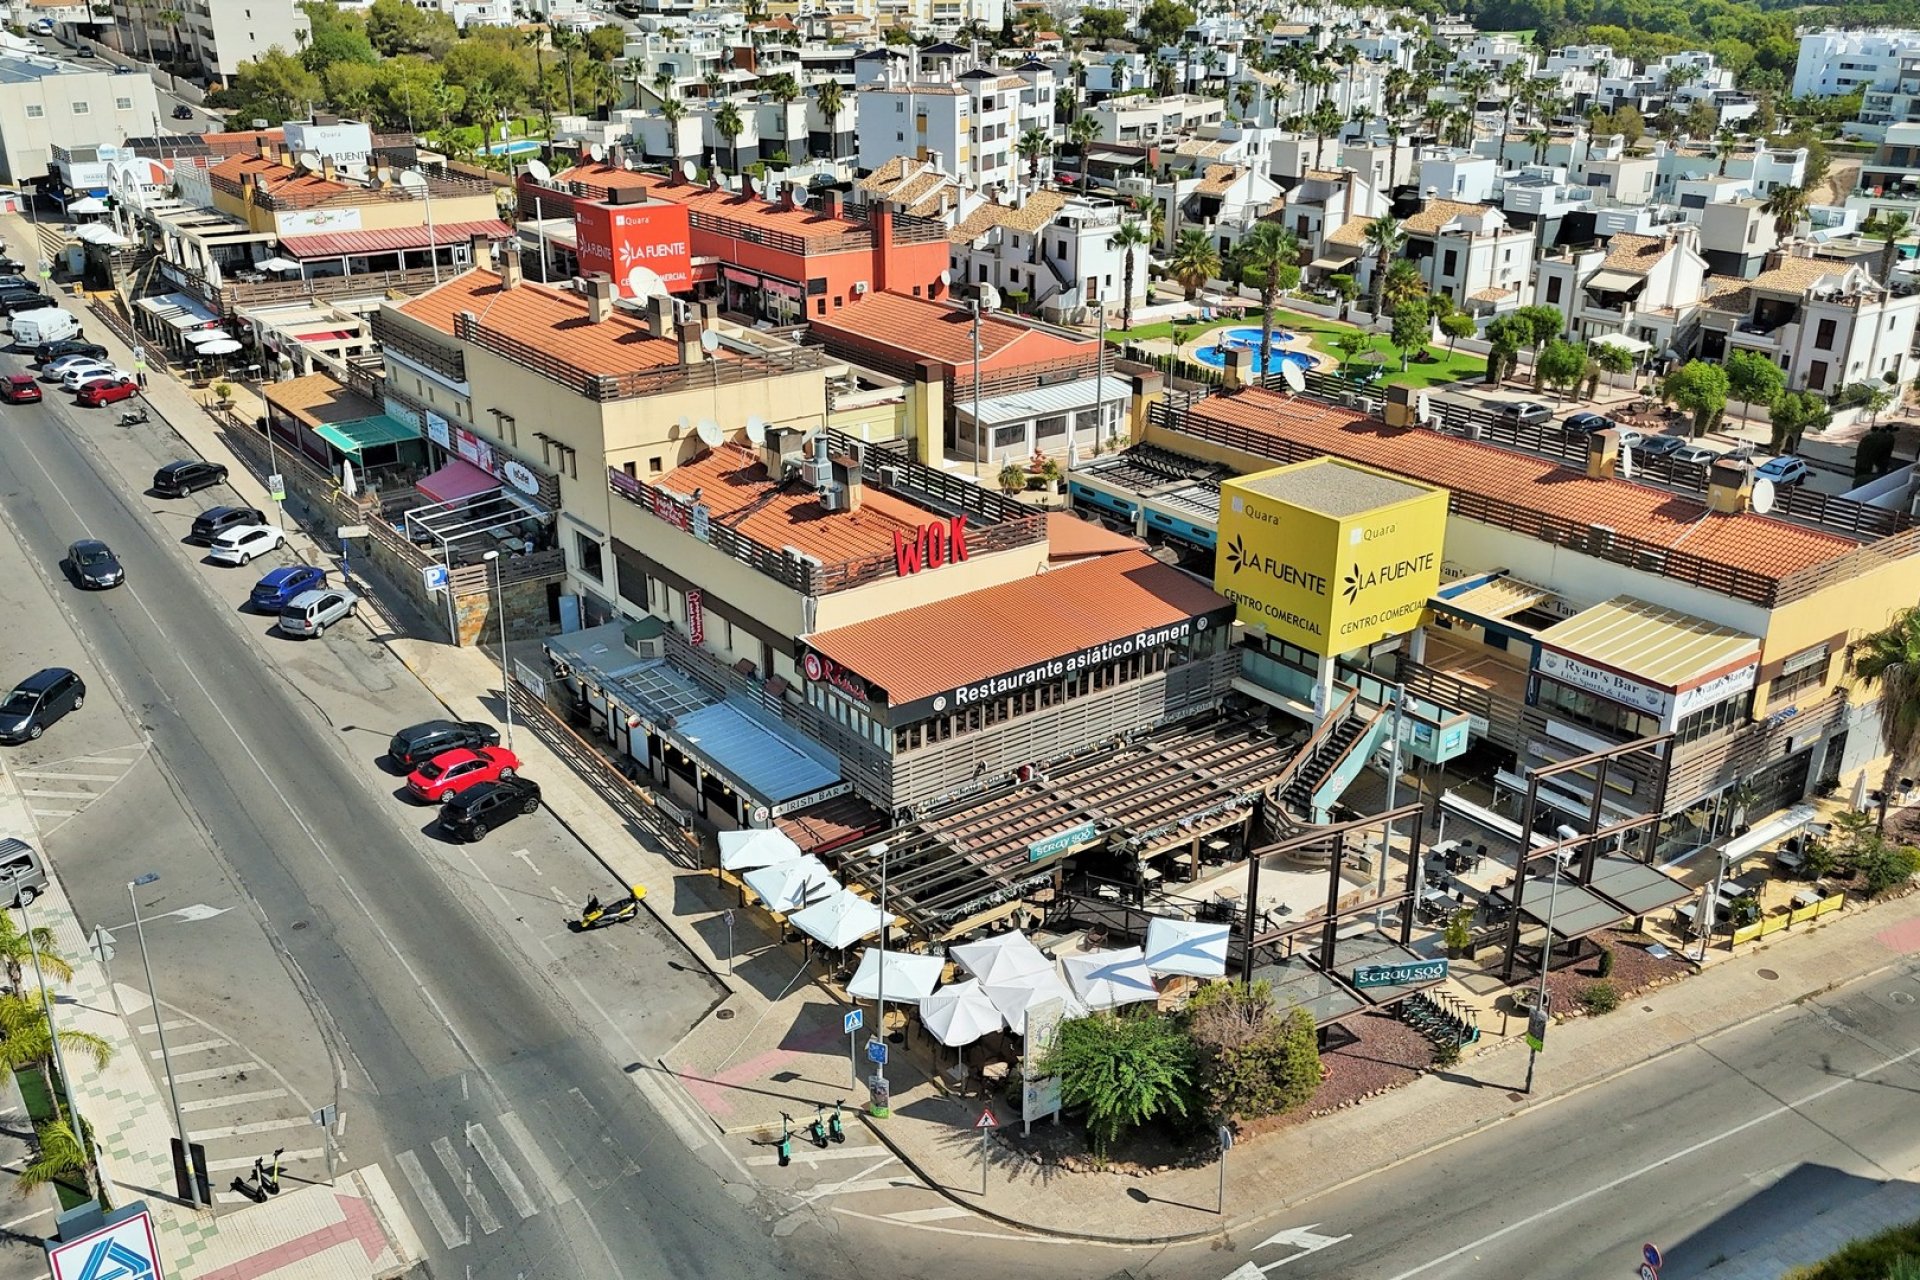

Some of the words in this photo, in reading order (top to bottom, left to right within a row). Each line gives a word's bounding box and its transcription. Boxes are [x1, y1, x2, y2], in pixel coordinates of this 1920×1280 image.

[625, 217, 650, 225] Quara
[631, 246, 645, 259] LA
[646, 242, 686, 258] FUENTE
[1245, 504, 1280, 526] Quara
[894, 514, 969, 577] WOK
[1363, 523, 1396, 541] Quara
[427, 569, 440, 588] P
[1242, 549, 1262, 572] LA
[1265, 558, 1327, 596] FUENTE
[1358, 570, 1377, 591] LA
[1379, 552, 1434, 582] FUENTE
[1223, 588, 1262, 612] CENTRO
[1264, 604, 1322, 636] COMERCIAL
[1340, 614, 1378, 635] CENTRO
[1380, 599, 1428, 622] COMERCIAL
[956, 663, 1063, 706] Restaurante
[1067, 640, 1132, 672] asiático
[1135, 622, 1190, 650] Ramen
[1565, 660, 1609, 683] Ryan's
[1614, 677, 1640, 693] Bar
[1579, 678, 1604, 692] Sports
